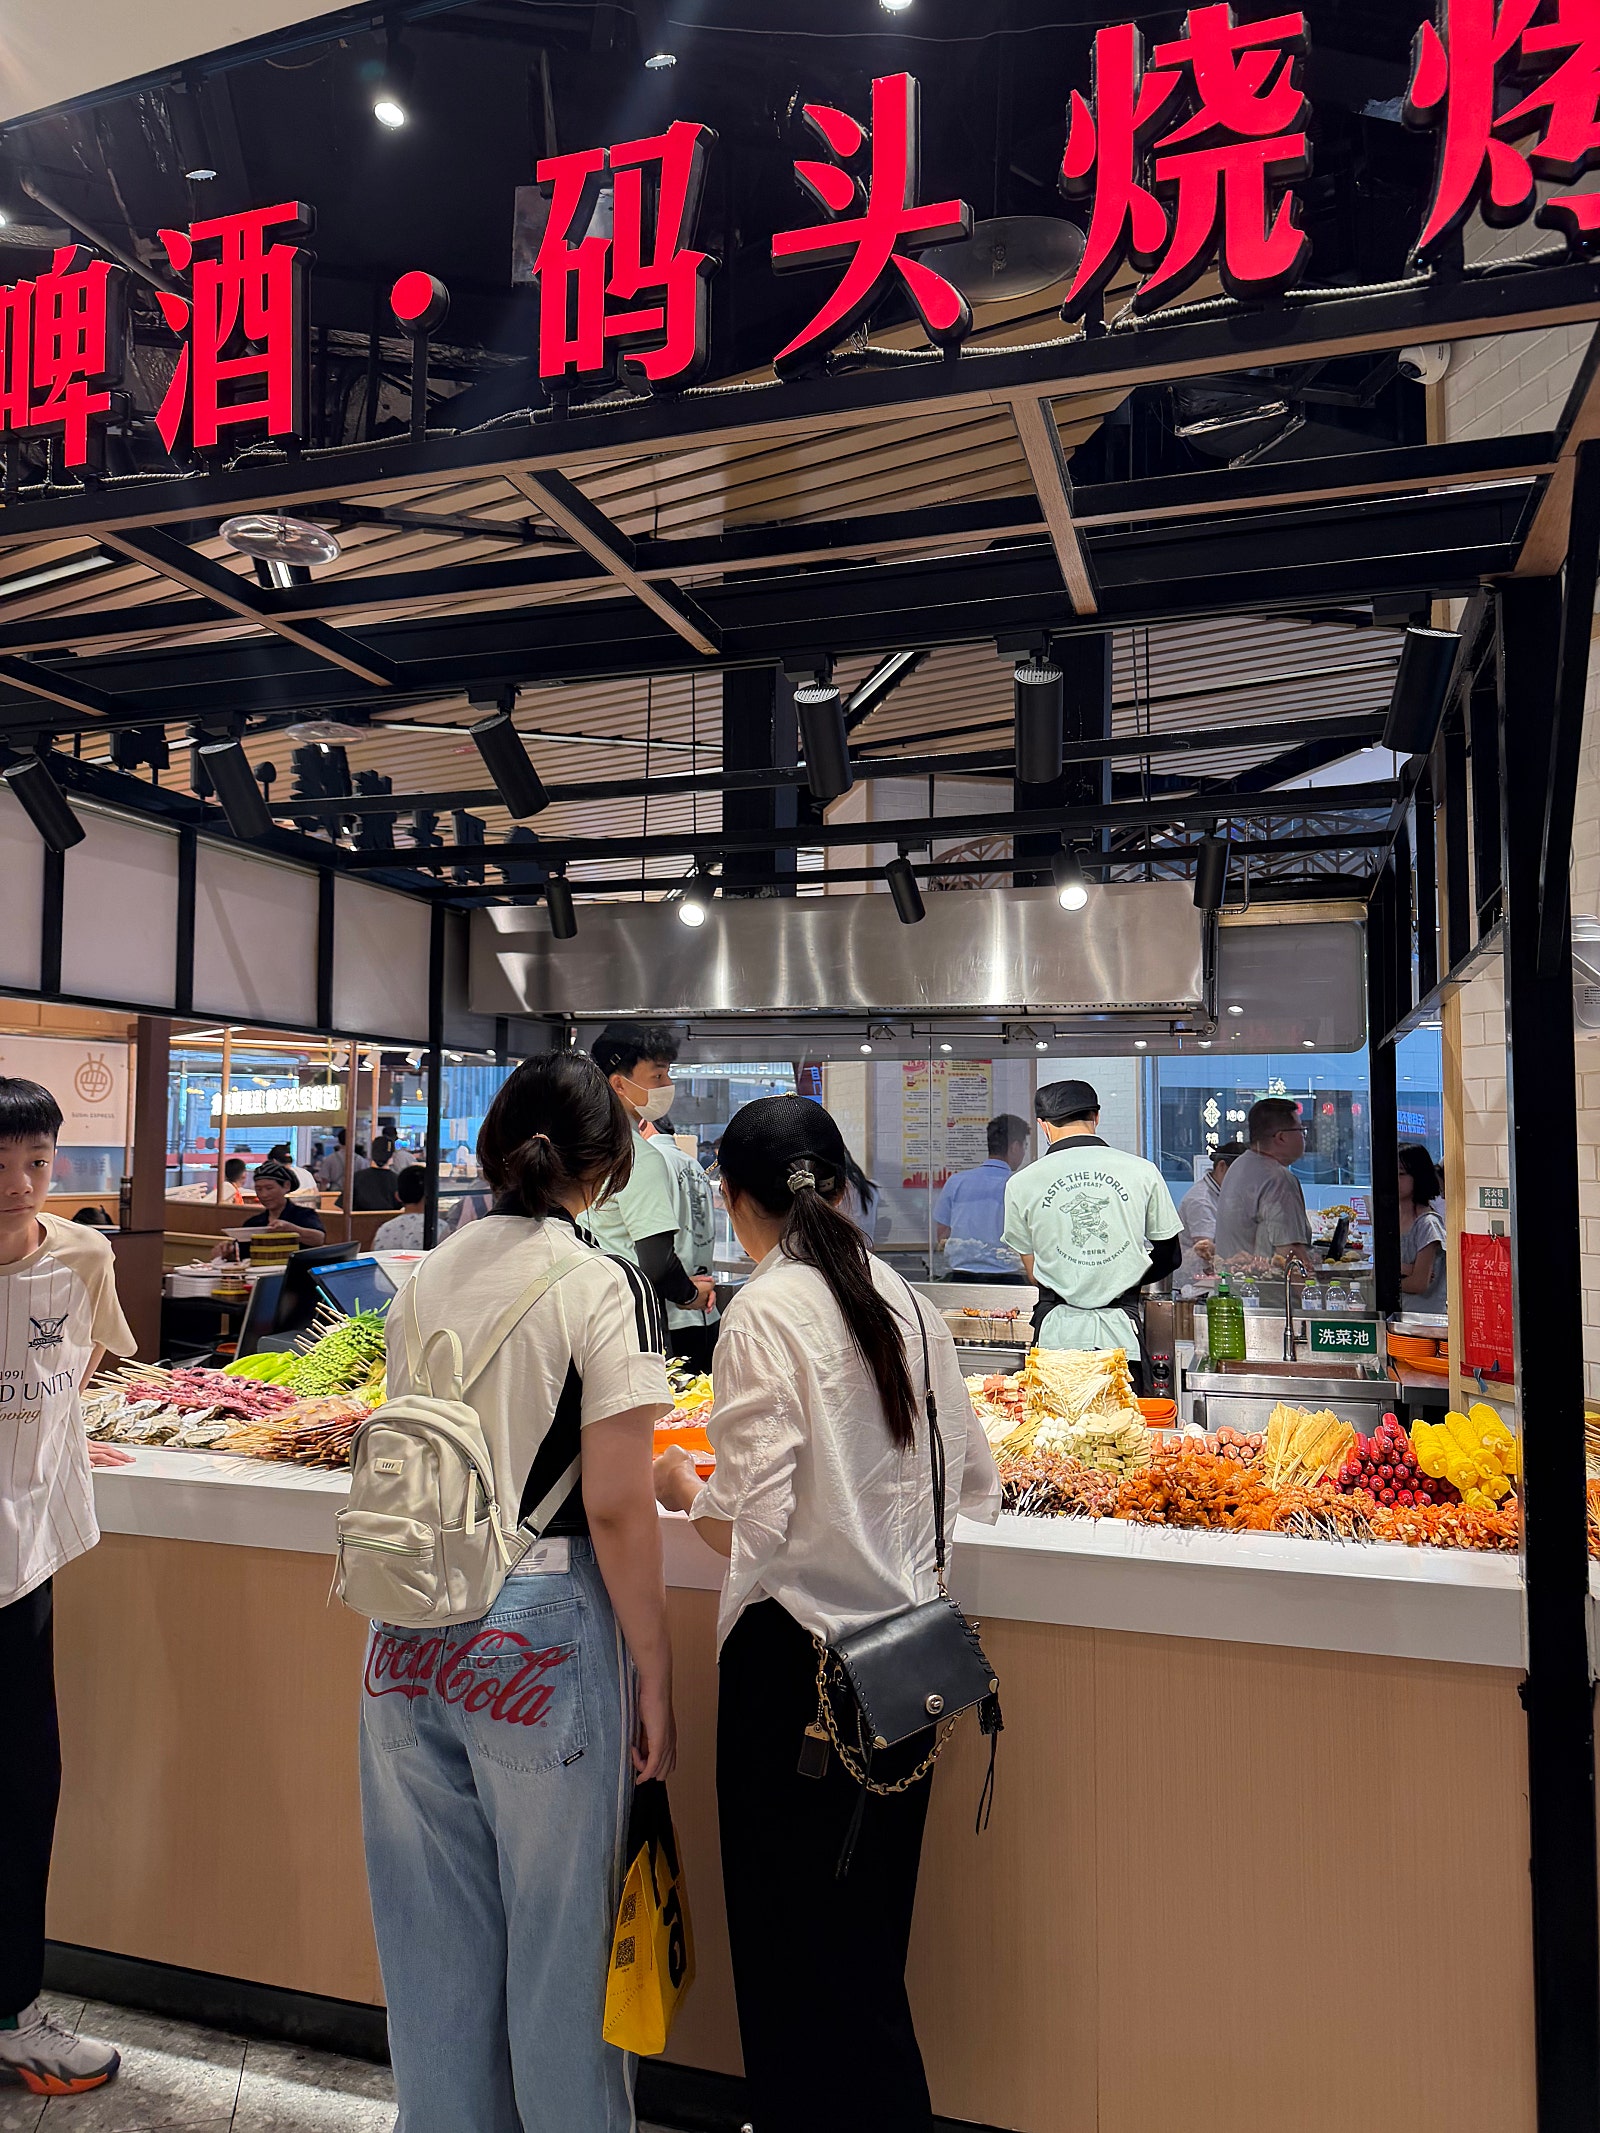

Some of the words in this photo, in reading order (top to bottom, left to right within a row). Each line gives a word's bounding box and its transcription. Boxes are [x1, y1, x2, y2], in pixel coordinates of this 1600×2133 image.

[1042, 1178, 1067, 1209] TASTE
[1066, 1171, 1090, 1183] THE
[1094, 1171, 1129, 1202] WORLD
[1066, 1181, 1082, 1192] DAILY
[1083, 1181, 1103, 1189] FEAST
[1484, 1188, 1504, 1198] 灭火毯
[1484, 1198, 1504, 1208] 放置处
[1067, 1255, 1077, 1264] THE
[1102, 1255, 1112, 1264] ONE
[1469, 1258, 1509, 1273] 灭火毯
[1318, 1328, 1370, 1346] 洗菜池
[23, 1369, 75, 1401] UNITY
